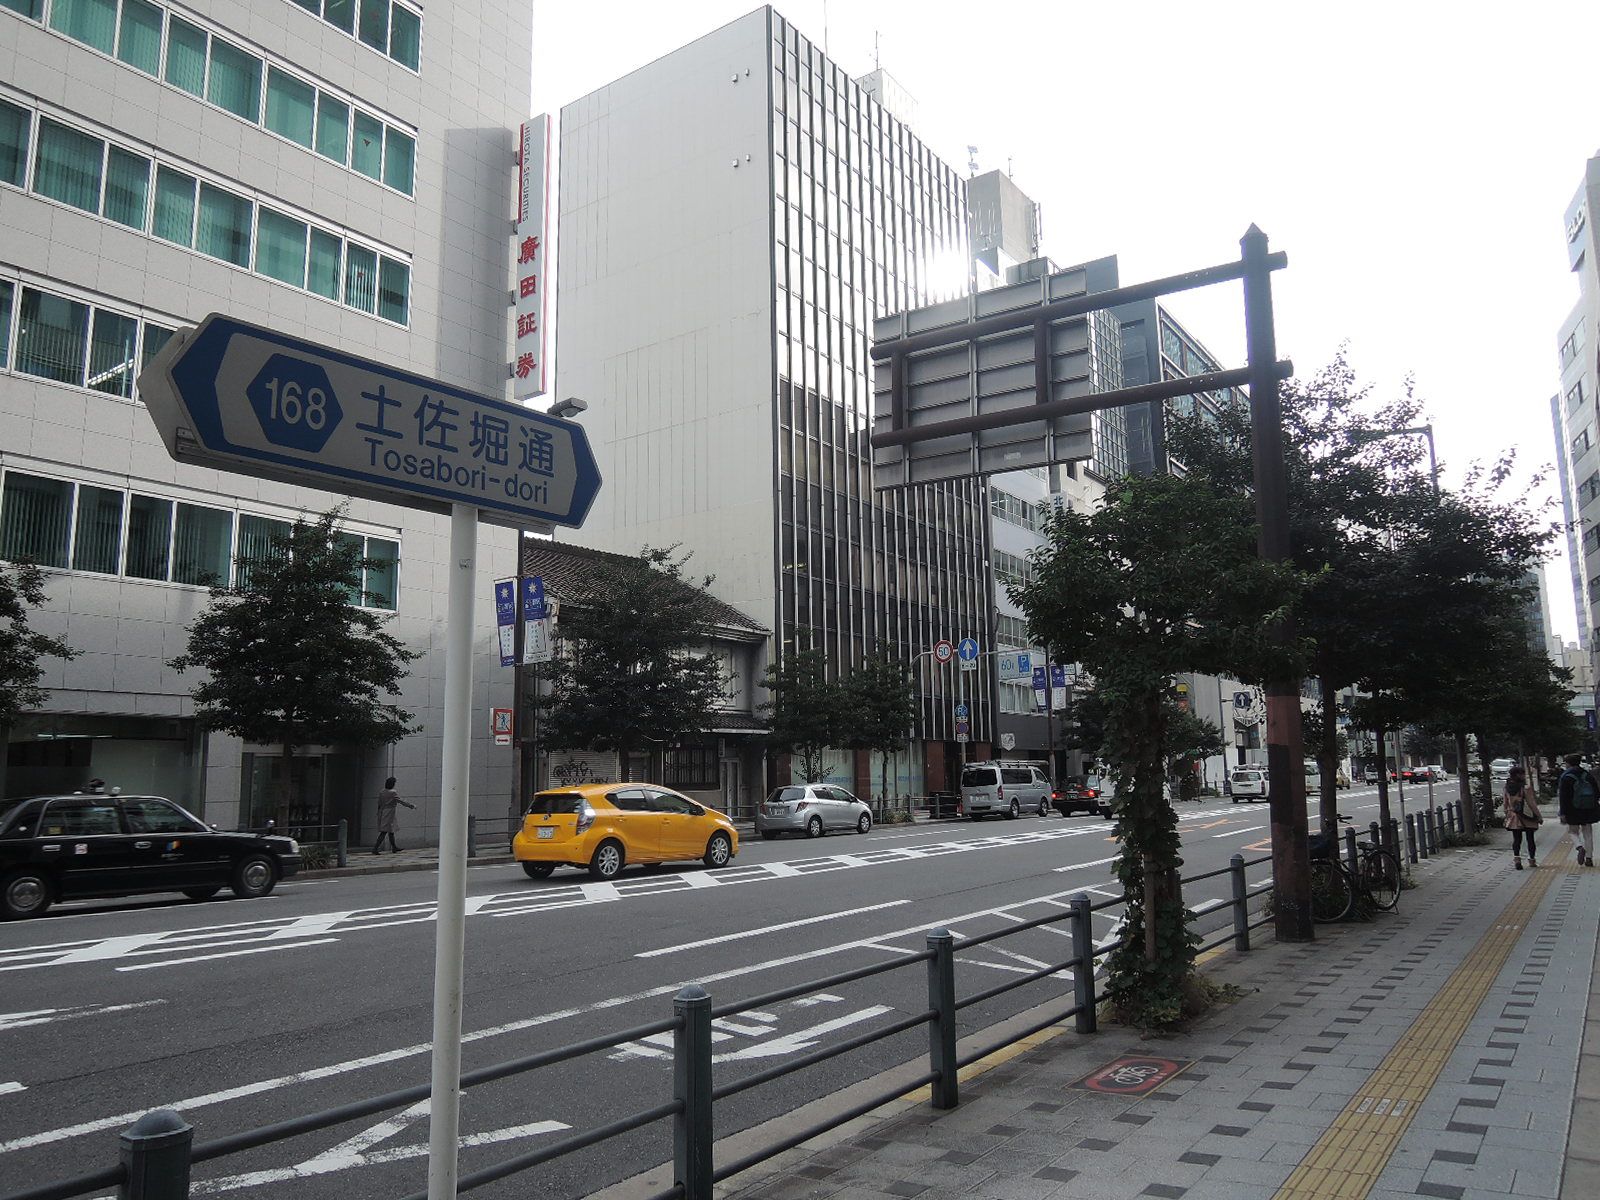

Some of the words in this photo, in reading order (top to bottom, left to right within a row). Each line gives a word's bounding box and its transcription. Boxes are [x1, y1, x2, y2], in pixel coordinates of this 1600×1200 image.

[265, 377, 328, 431] 168
[355, 385, 555, 478] 土佐堀通
[364, 438, 548, 505] Tosabori-dori
[938, 646, 950, 656] 50
